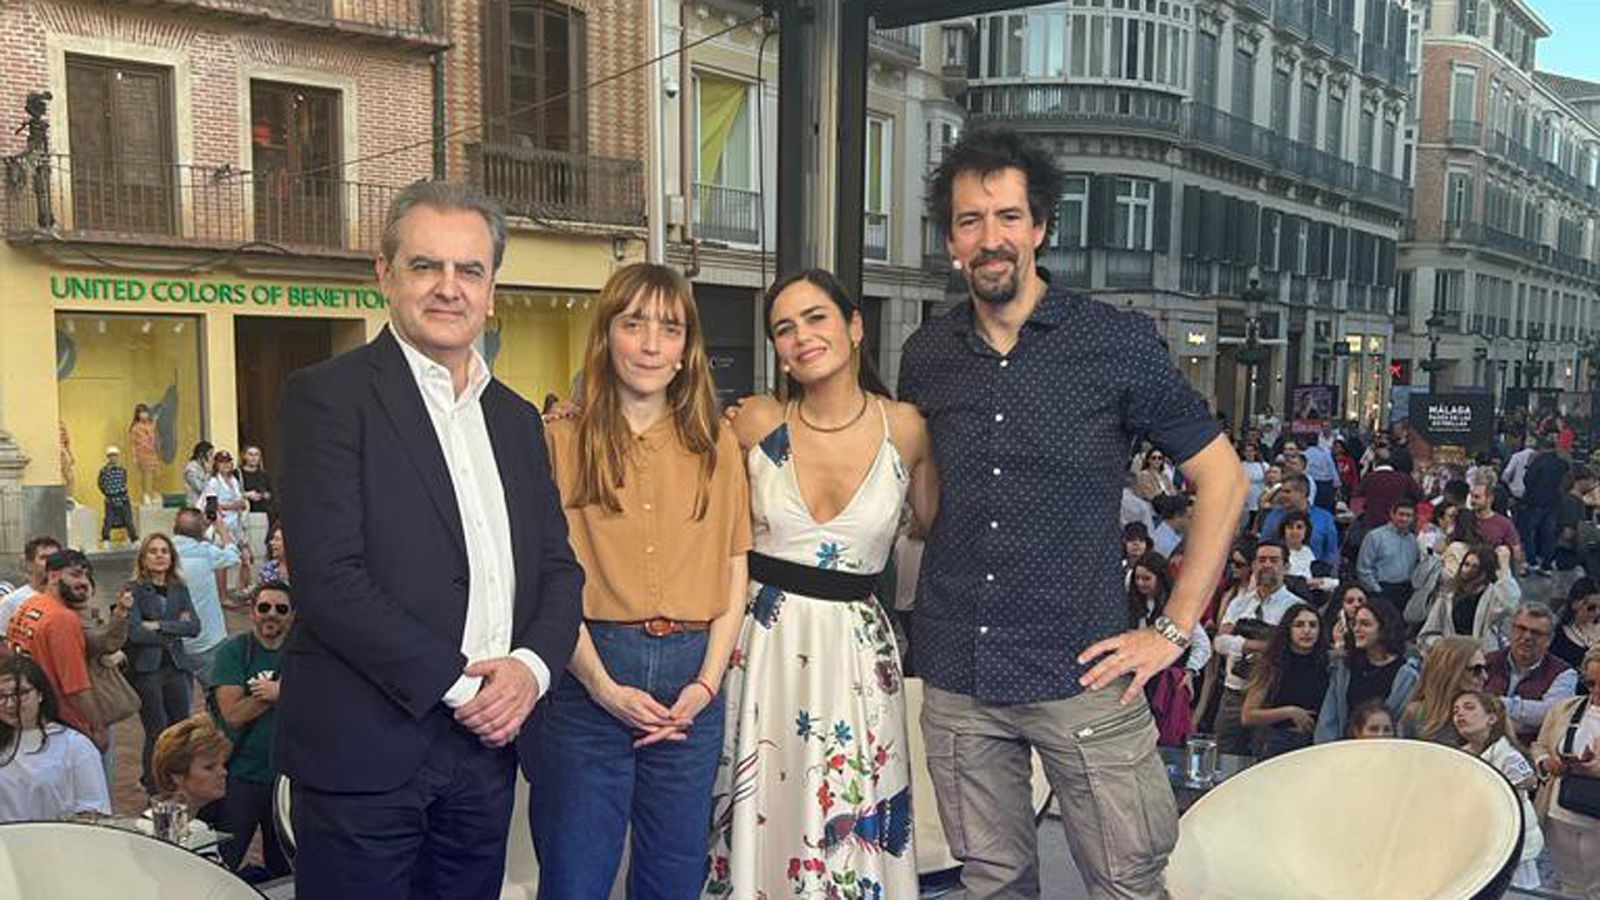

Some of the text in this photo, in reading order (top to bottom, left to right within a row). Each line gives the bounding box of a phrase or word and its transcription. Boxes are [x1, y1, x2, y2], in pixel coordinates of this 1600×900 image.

[51, 275, 146, 301] UNITED
[151, 280, 247, 304] COLORS
[252, 285, 281, 305] OF
[1428, 403, 1471, 414] MÁLAGA
